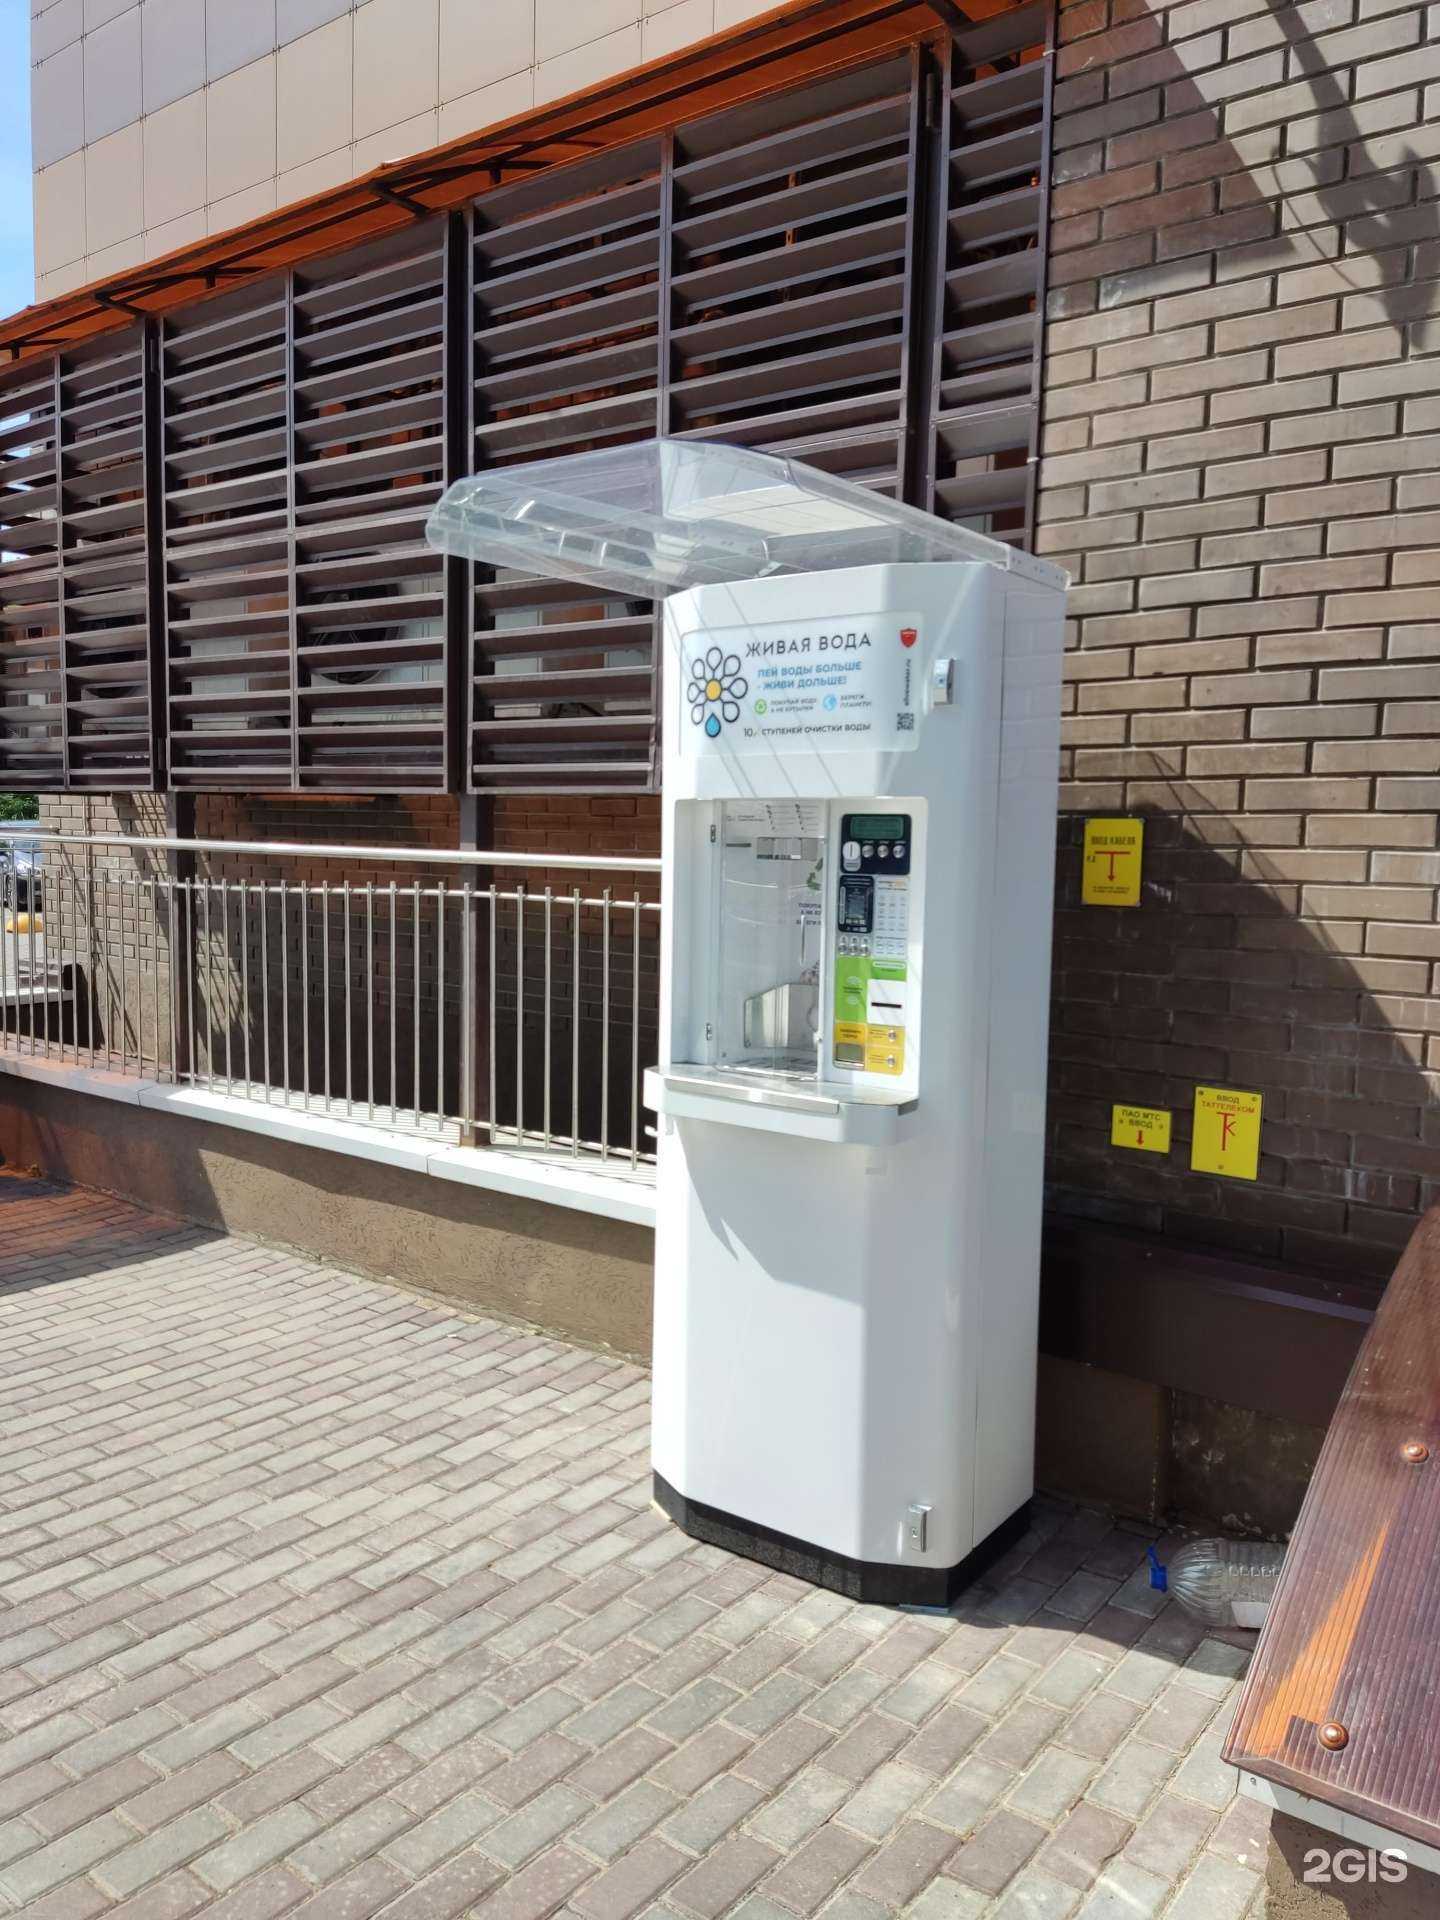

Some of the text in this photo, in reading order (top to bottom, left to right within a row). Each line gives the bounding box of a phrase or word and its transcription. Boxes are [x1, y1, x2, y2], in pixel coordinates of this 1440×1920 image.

[746, 632, 871, 657] ЖИВАЯ ВОДА
[758, 661, 863, 678] ПЕЙ ВОДЫ БОЛЬШЕ
[763, 679, 794, 690] ЖИВИ
[798, 675, 847, 688] ДОЛЬШЕ!
[762, 725, 802, 736] СТУПЕНЕЙ
[804, 724, 842, 734] ОЧИСТКИ
[845, 723, 871, 732] ВОДЫ
[1216, 1094, 1239, 1104] ВВОД
[1121, 1109, 1161, 1120] ПАО МТС
[1129, 1118, 1153, 1129] ВВОД
